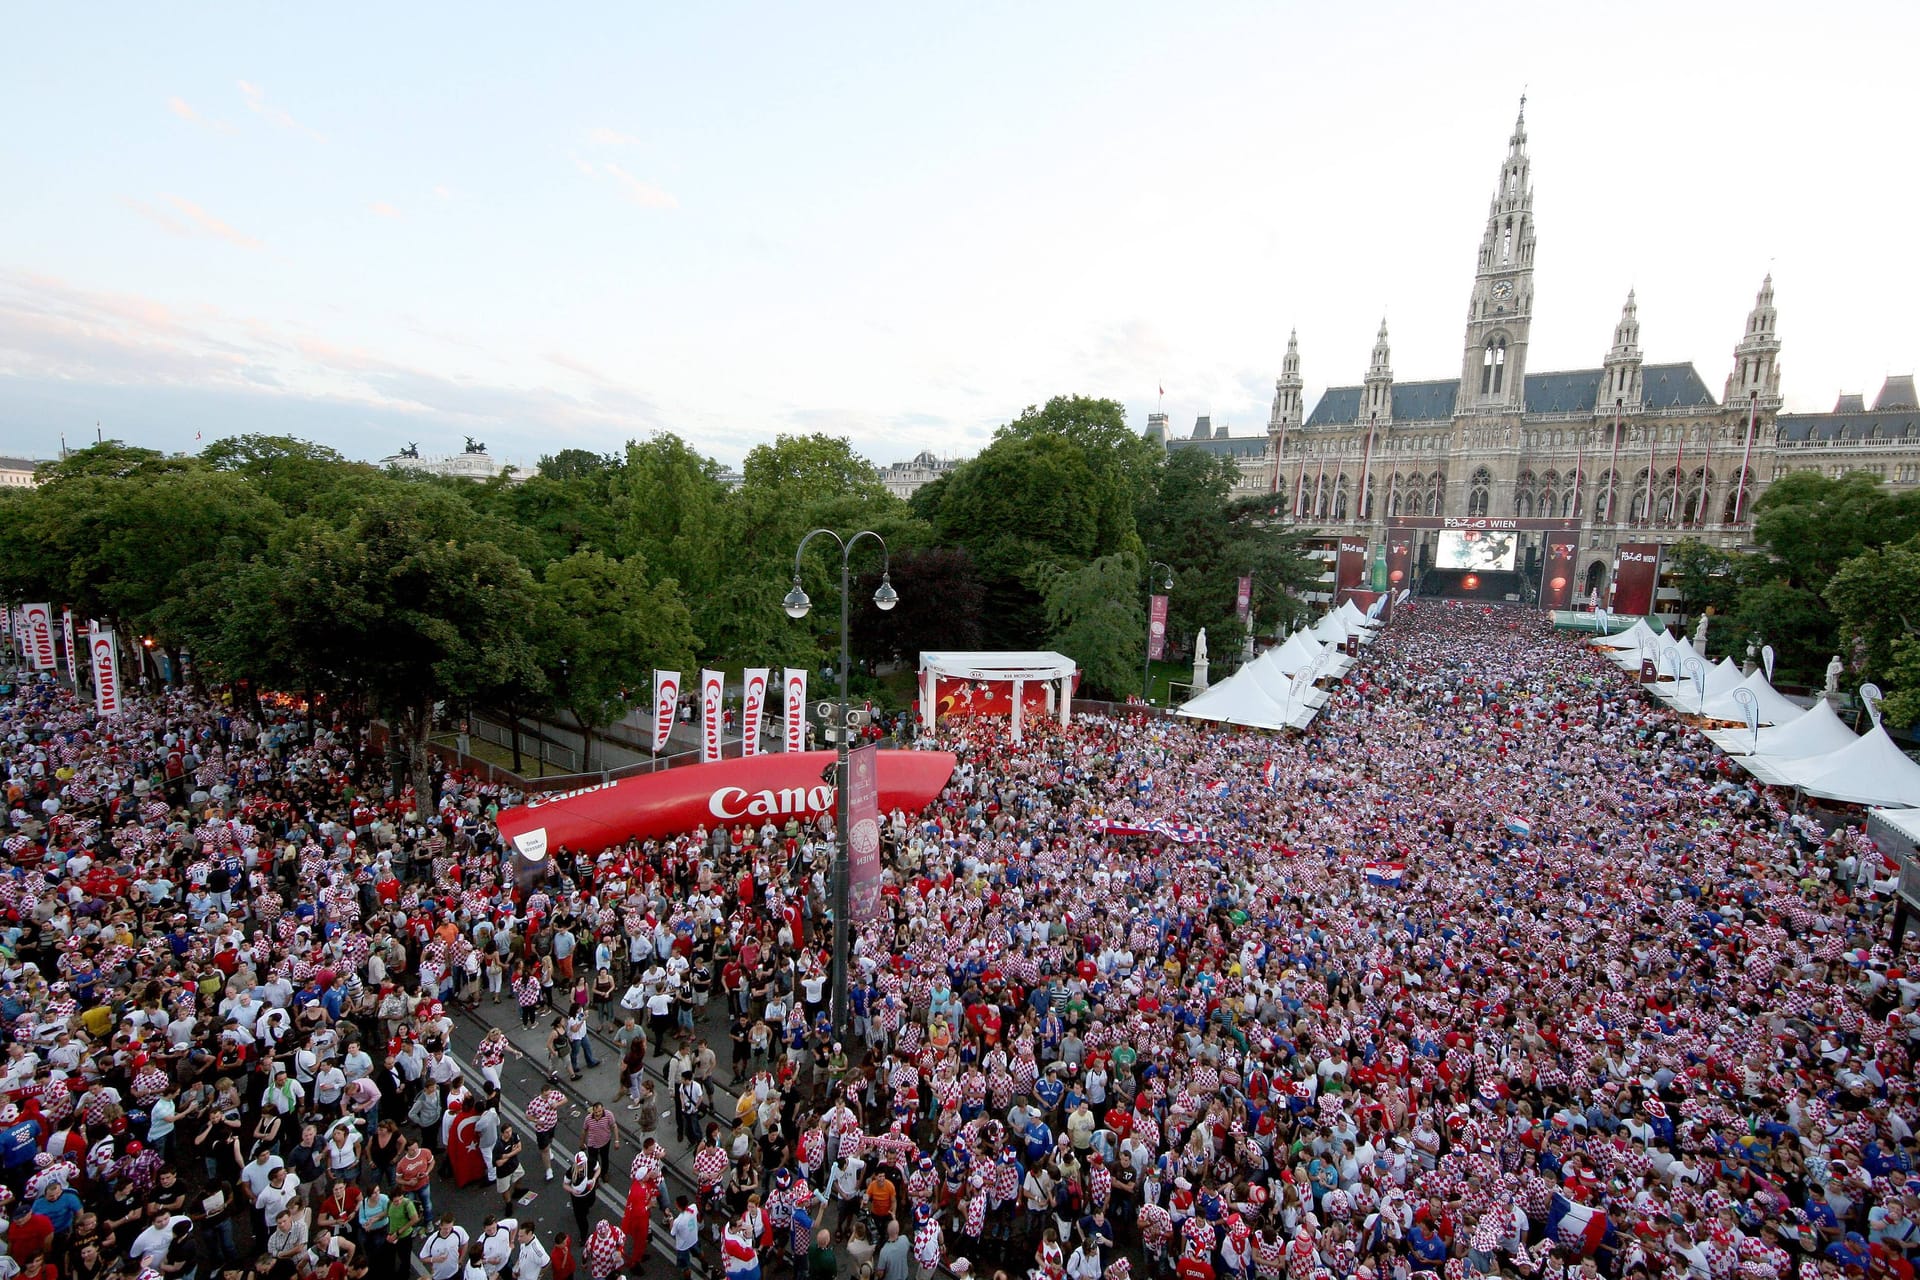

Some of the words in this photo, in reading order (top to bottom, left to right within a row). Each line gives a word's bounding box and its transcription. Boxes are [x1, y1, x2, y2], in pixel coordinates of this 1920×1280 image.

[1490, 519, 1516, 528] WIEN
[29, 609, 54, 665] Canon
[95, 639, 115, 710] Canon
[706, 678, 721, 759] Canon
[745, 677, 765, 756] Canon
[709, 785, 838, 818] Cano
[1123, 1171, 1133, 1180] 37
